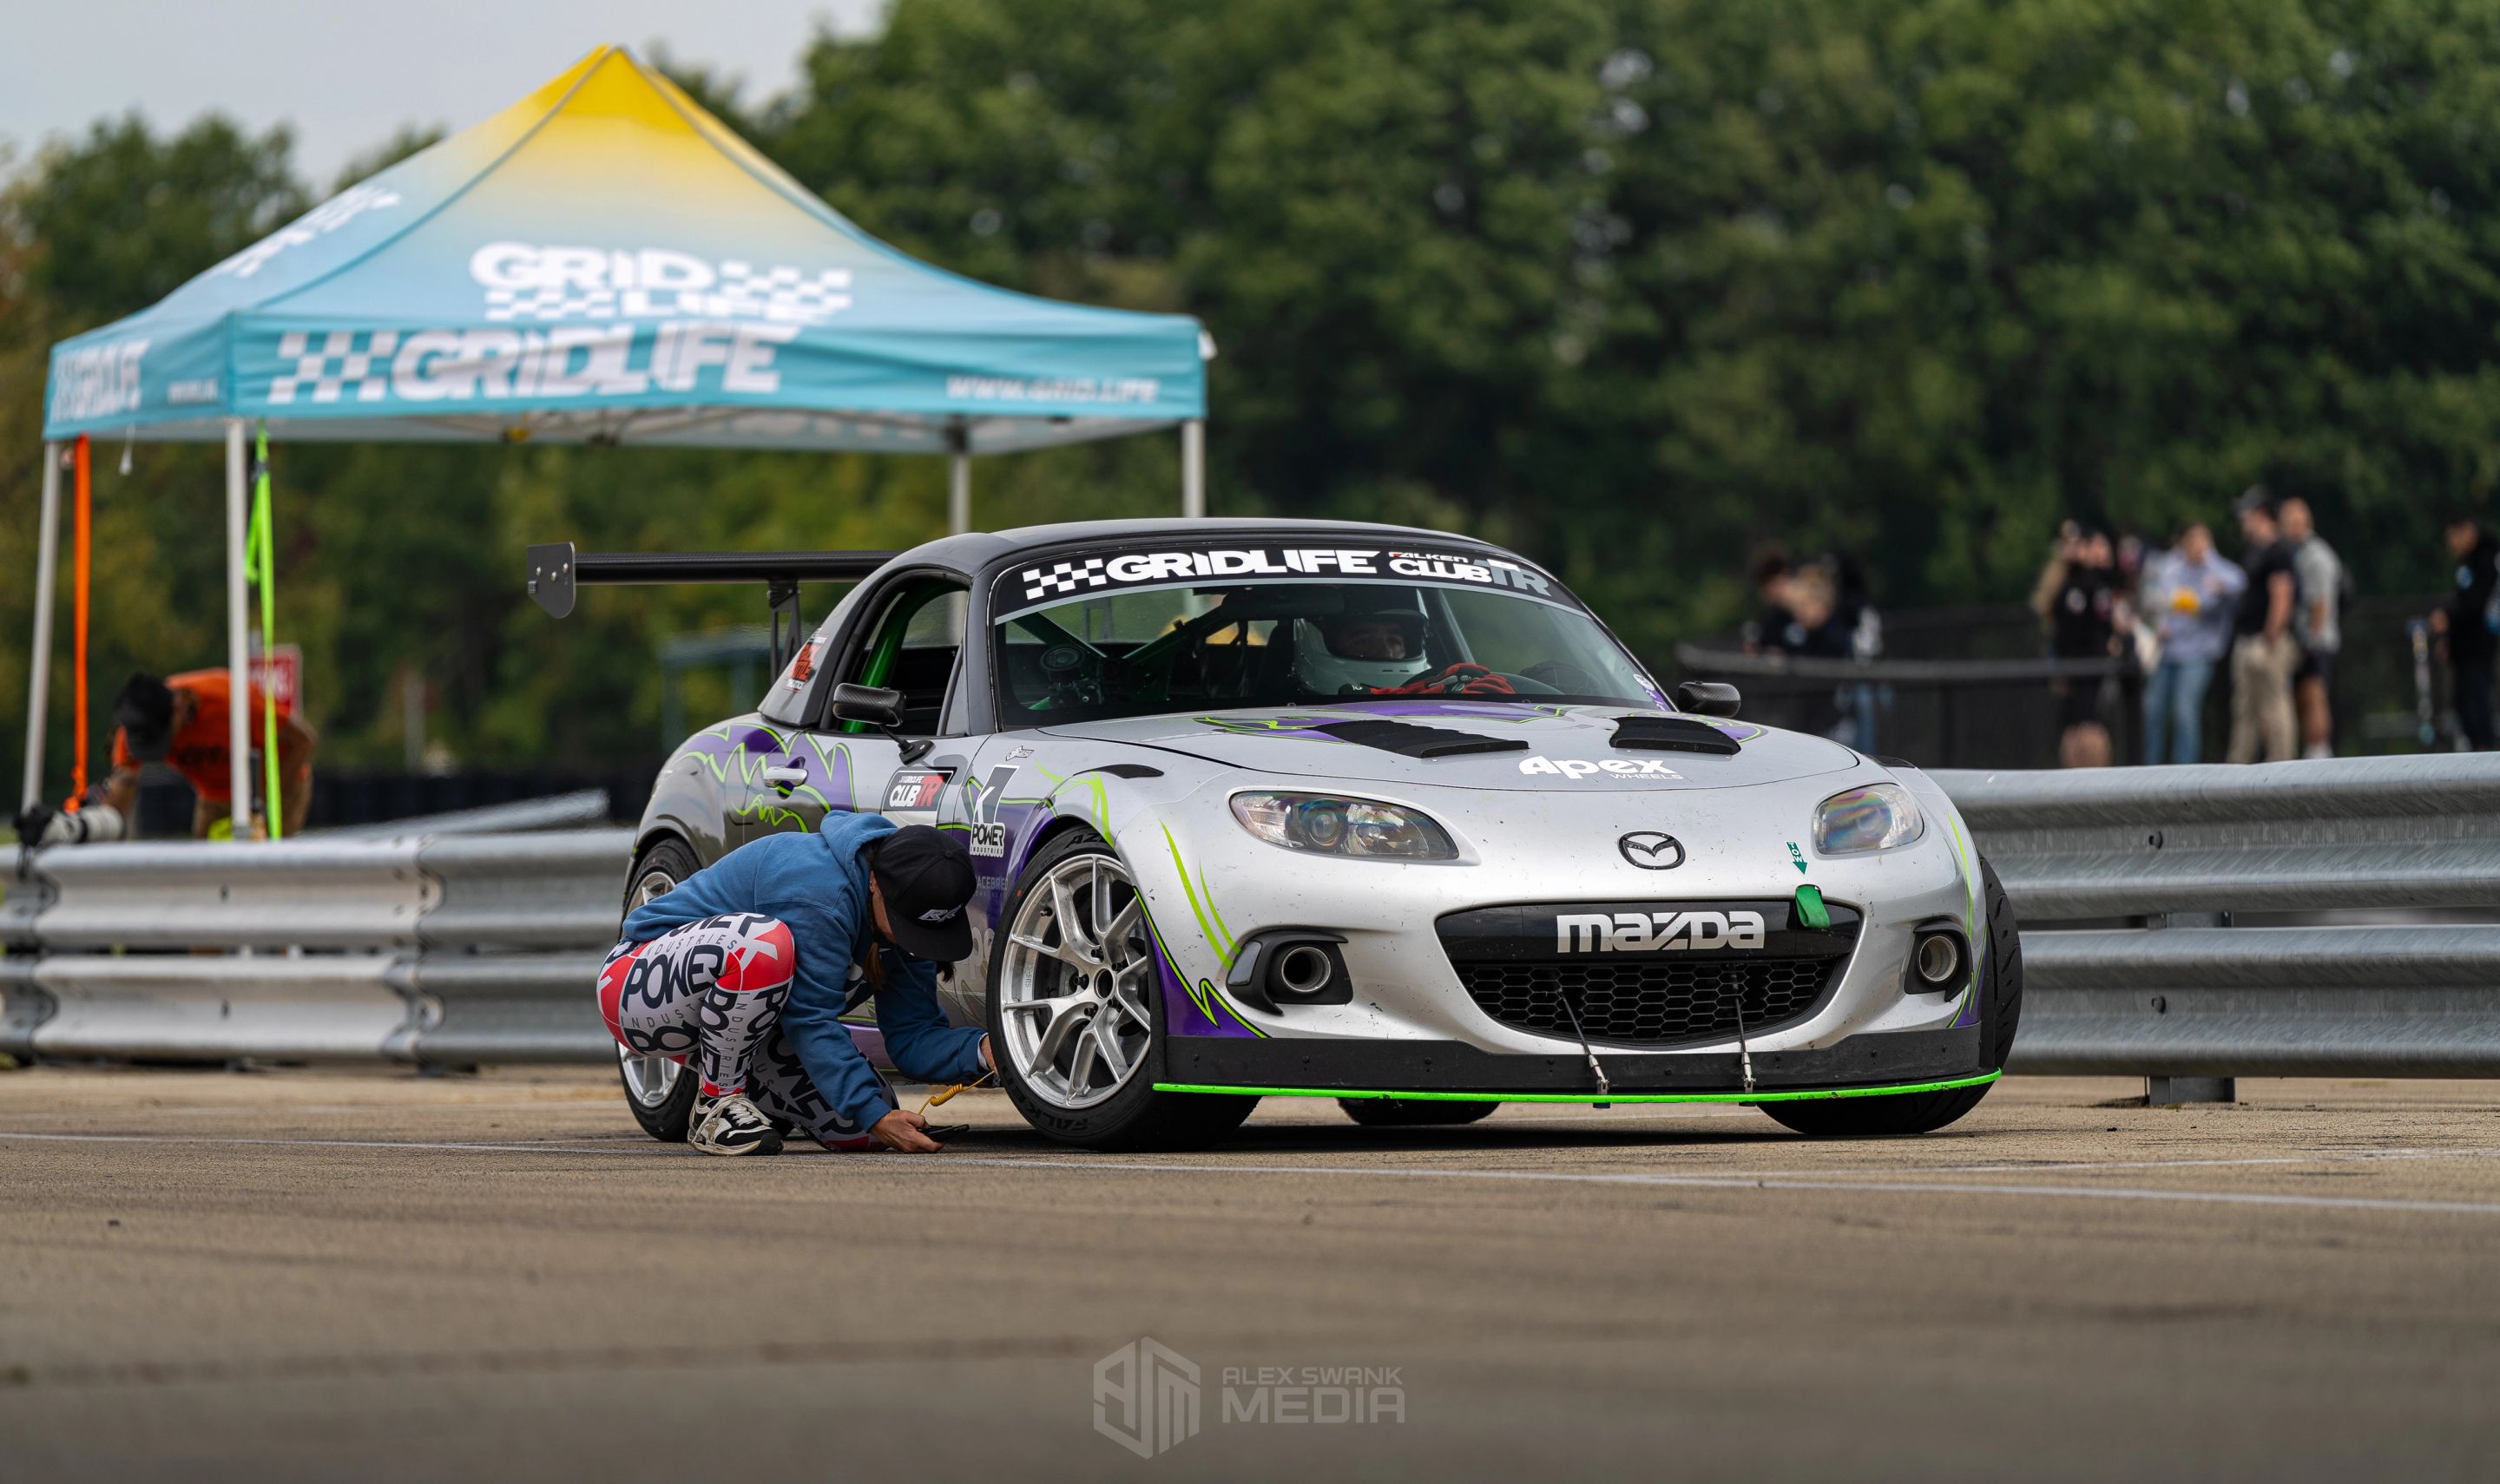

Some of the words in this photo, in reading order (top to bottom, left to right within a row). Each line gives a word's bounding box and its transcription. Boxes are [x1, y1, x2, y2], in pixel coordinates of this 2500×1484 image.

[470, 242, 715, 292] GRID
[393, 319, 802, 402] GRIDLIFE
[1106, 549, 1380, 581] GRIDLIFE
[1389, 551, 1469, 564] FALKEN
[1519, 756, 1679, 779] Apex
[971, 824, 1005, 846] POWER
[970, 847, 1003, 856] INDUSTRIES
[1788, 841, 1804, 863] TOW
[645, 933, 738, 956] NDUSTRIES
[621, 1002, 701, 1028] INDUST
